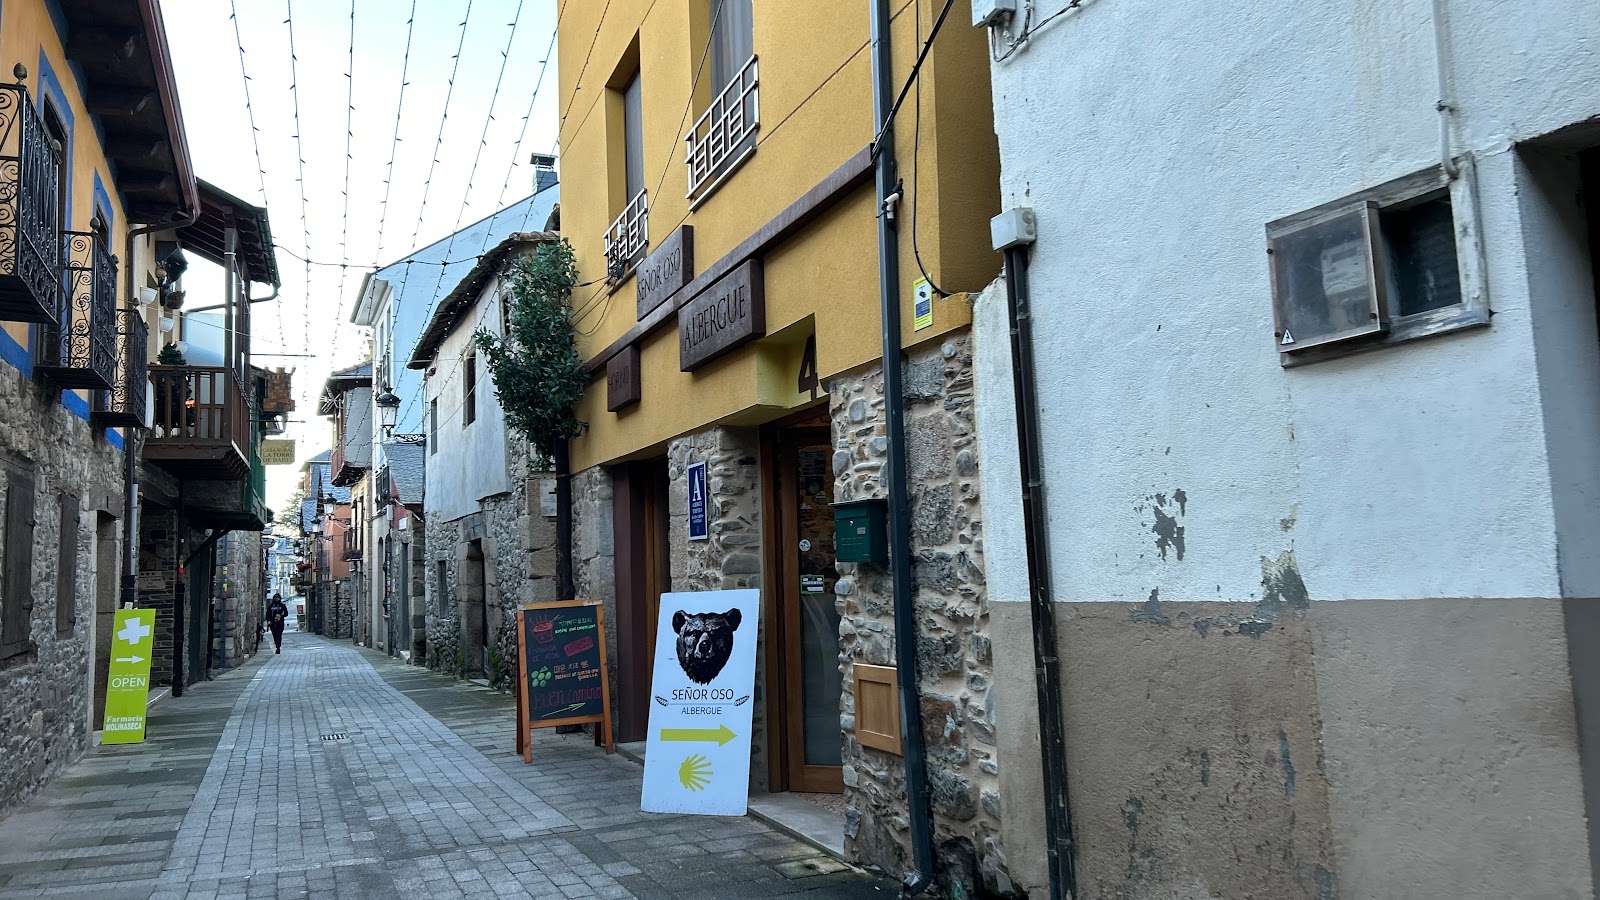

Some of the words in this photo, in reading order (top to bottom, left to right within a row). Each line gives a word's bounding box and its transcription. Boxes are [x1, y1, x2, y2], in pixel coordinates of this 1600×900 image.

[637, 264, 662, 303] SEÑOR
[663, 247, 681, 280] OSO
[683, 285, 746, 352] ALBERGUE
[798, 334, 818, 400] 4
[692, 470, 702, 501] A
[112, 677, 146, 688] OPEN
[672, 686, 708, 700] SEÑOR
[711, 688, 734, 700] OSO
[681, 706, 722, 715] ALBERGUE
[105, 722, 142, 731] MOLINASECA
